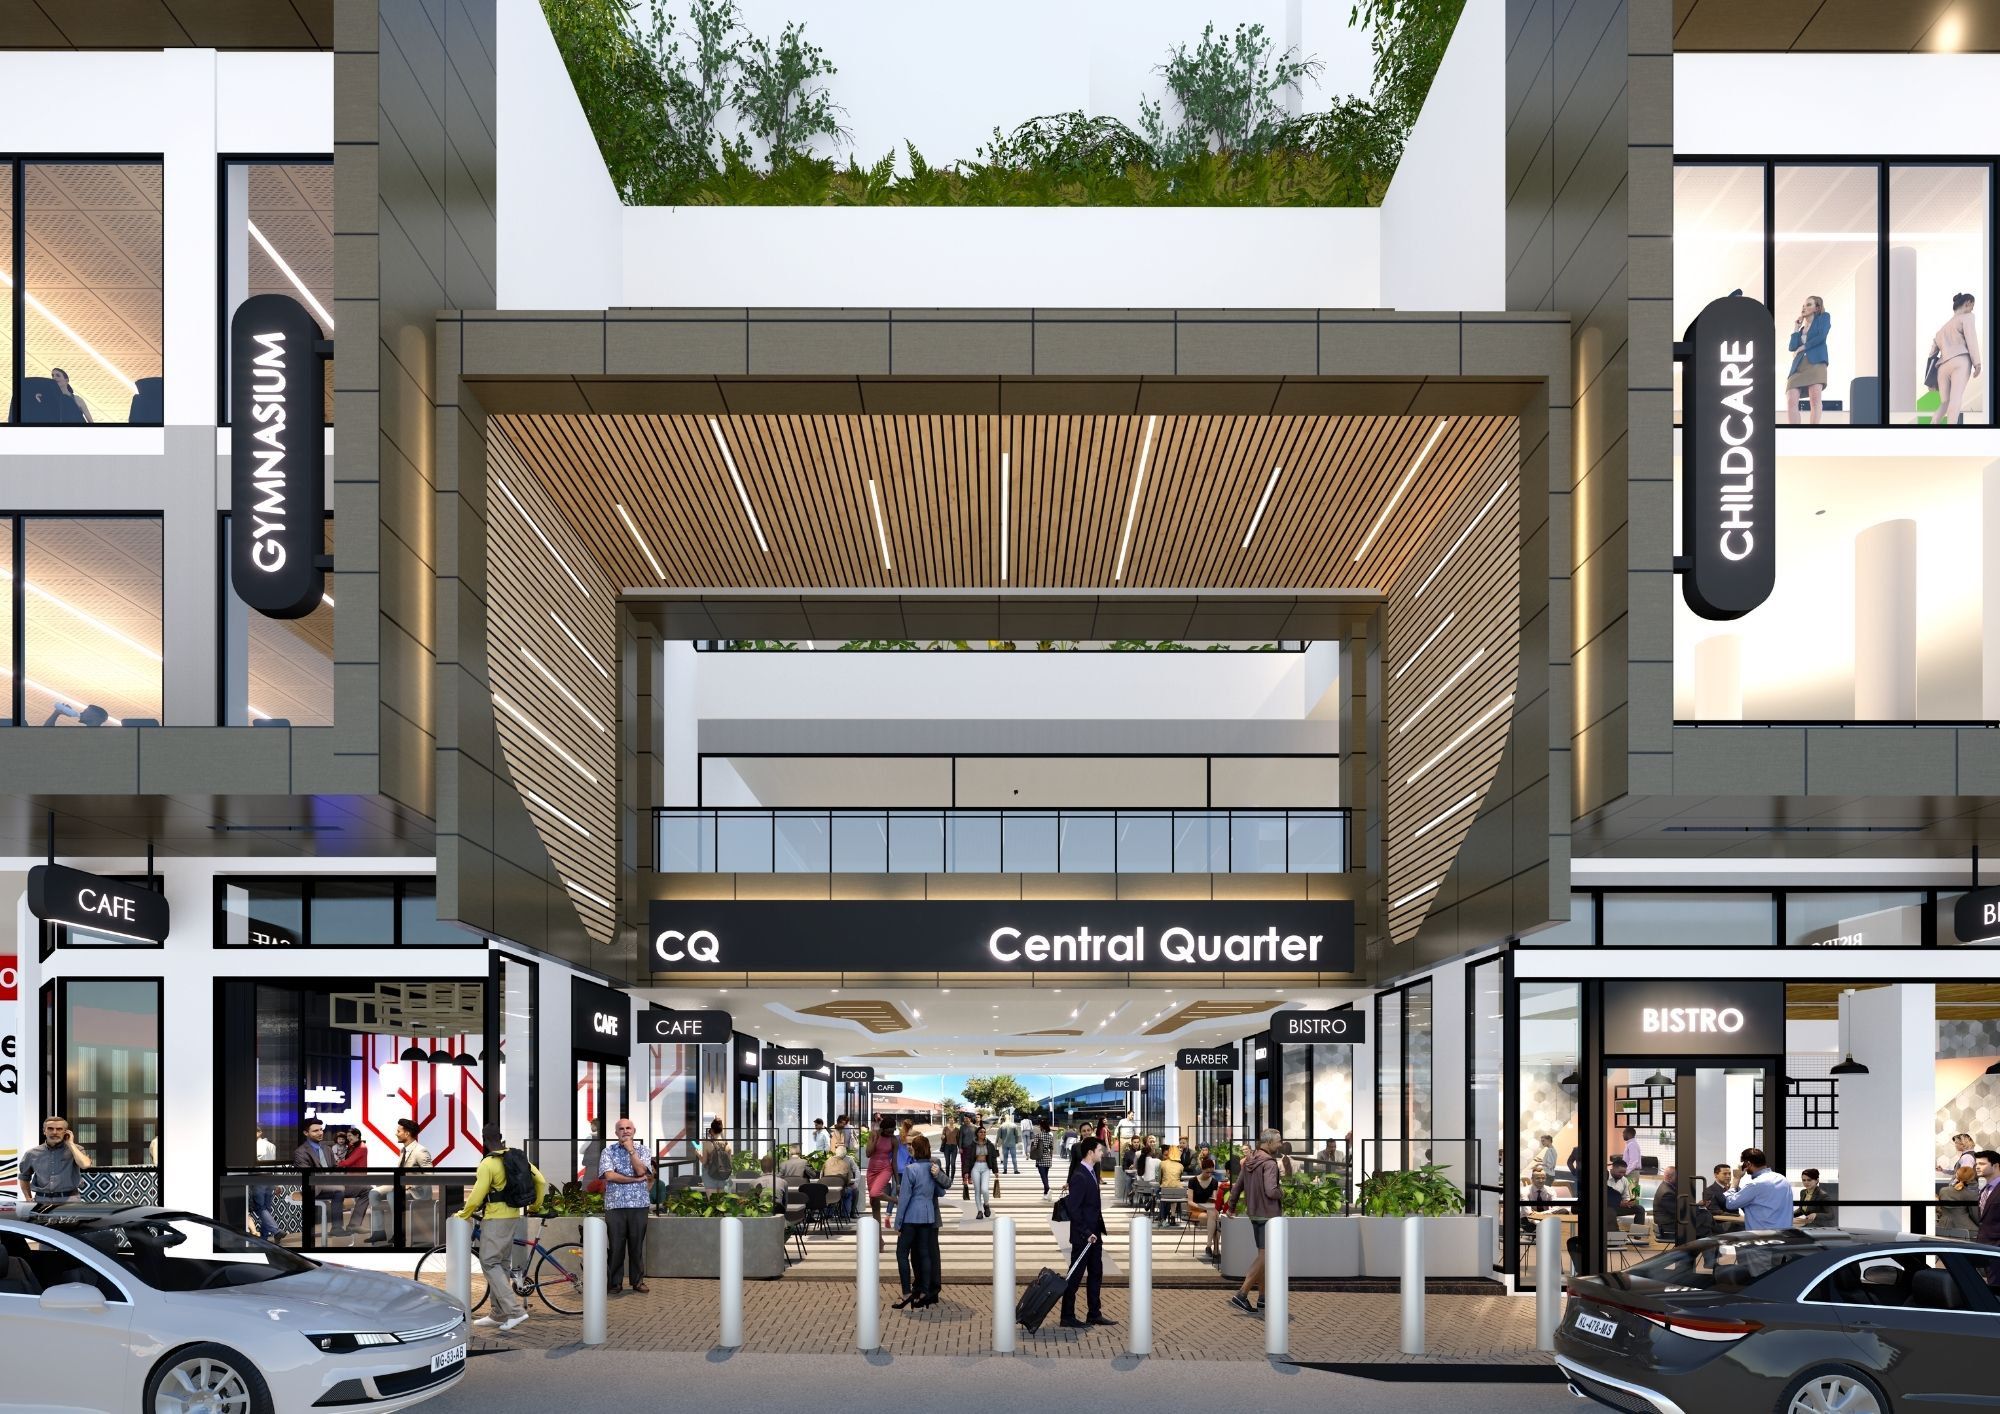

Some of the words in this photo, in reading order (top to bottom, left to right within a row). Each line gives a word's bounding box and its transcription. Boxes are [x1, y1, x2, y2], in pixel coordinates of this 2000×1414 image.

[252, 332, 287, 573] GYMNASIUM
[1720, 340, 1754, 561] CHILDCARE
[78, 888, 136, 922] CAFE
[656, 930, 720, 963] CQ
[989, 926, 1144, 962] Central
[1160, 926, 1323, 963] Quarter
[594, 1012, 618, 1036] CAFE
[656, 1020, 702, 1035] CAFE
[1289, 1019, 1347, 1034] BISTRO
[1643, 1007, 1744, 1033] BISTRO
[777, 1054, 808, 1065] SUSHI
[1185, 1054, 1229, 1065] BARBER
[841, 1071, 868, 1079] FOOD
[1115, 1080, 1130, 1088] KFC
